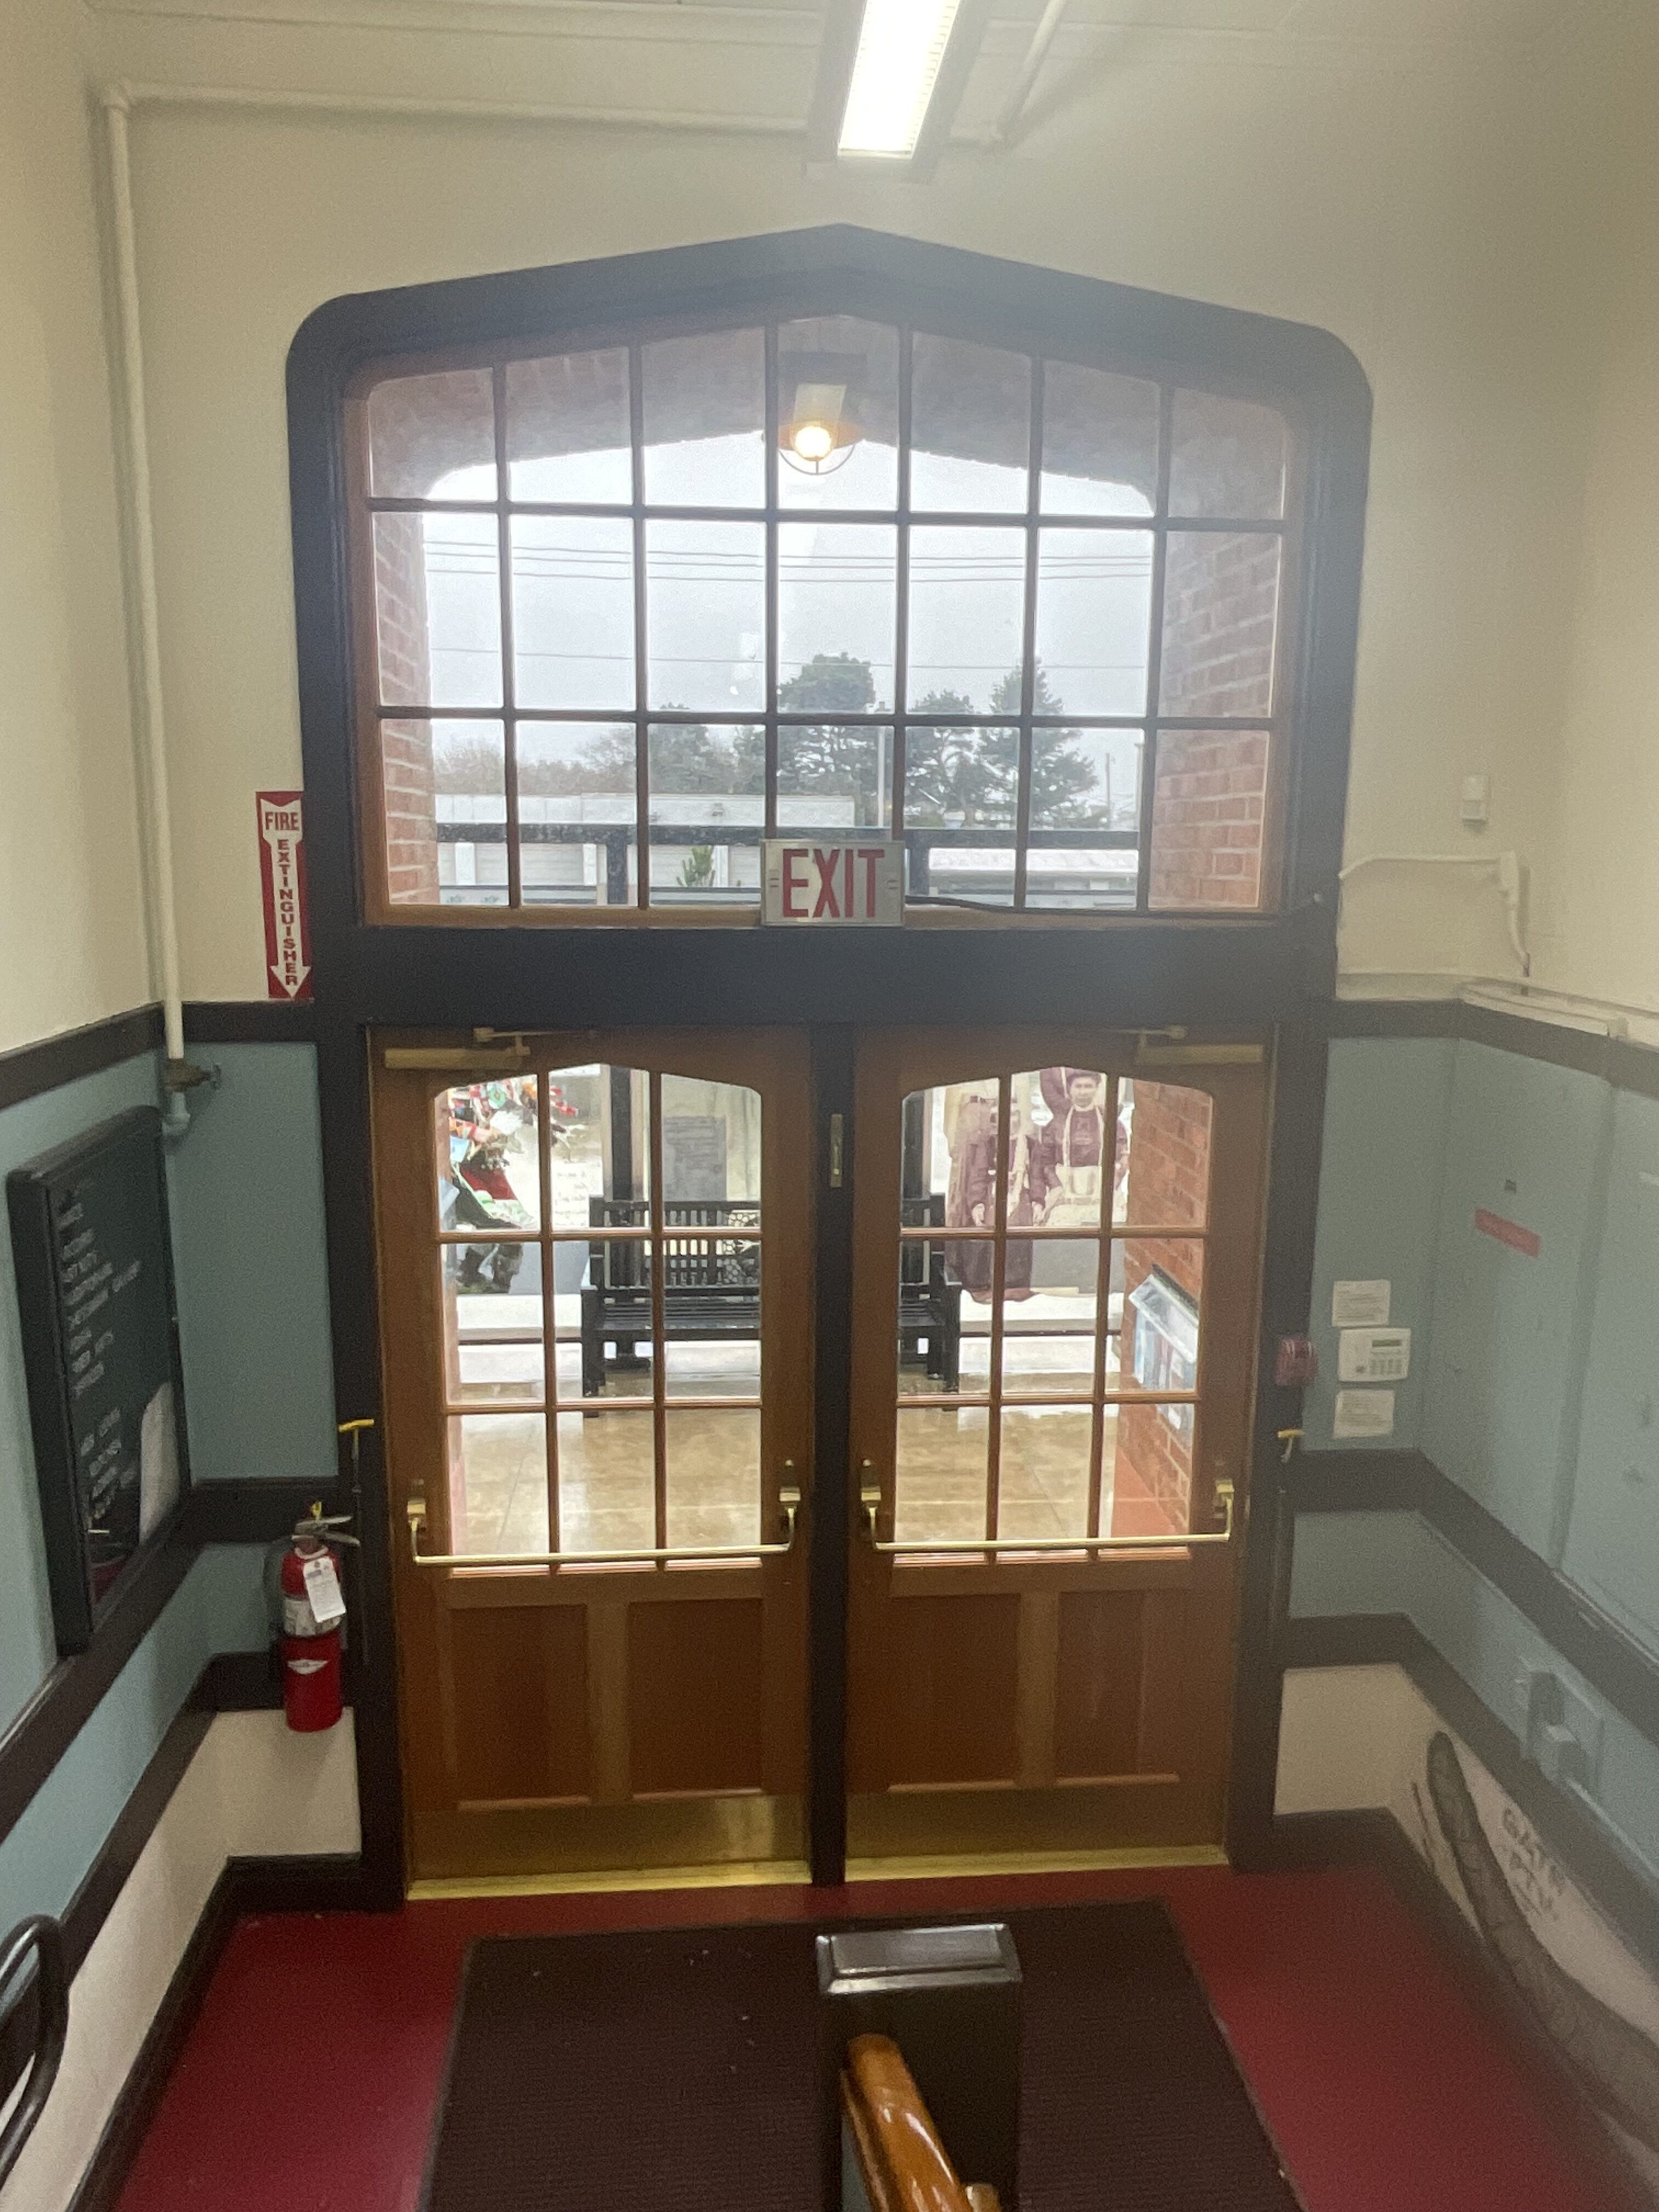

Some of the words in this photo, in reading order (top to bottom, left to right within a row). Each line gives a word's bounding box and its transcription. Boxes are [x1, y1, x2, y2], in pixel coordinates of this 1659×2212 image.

[264, 812, 299, 831] FIRE
[277, 839, 298, 985] EXTINGUISHER
[783, 849, 885, 918] EXIT
